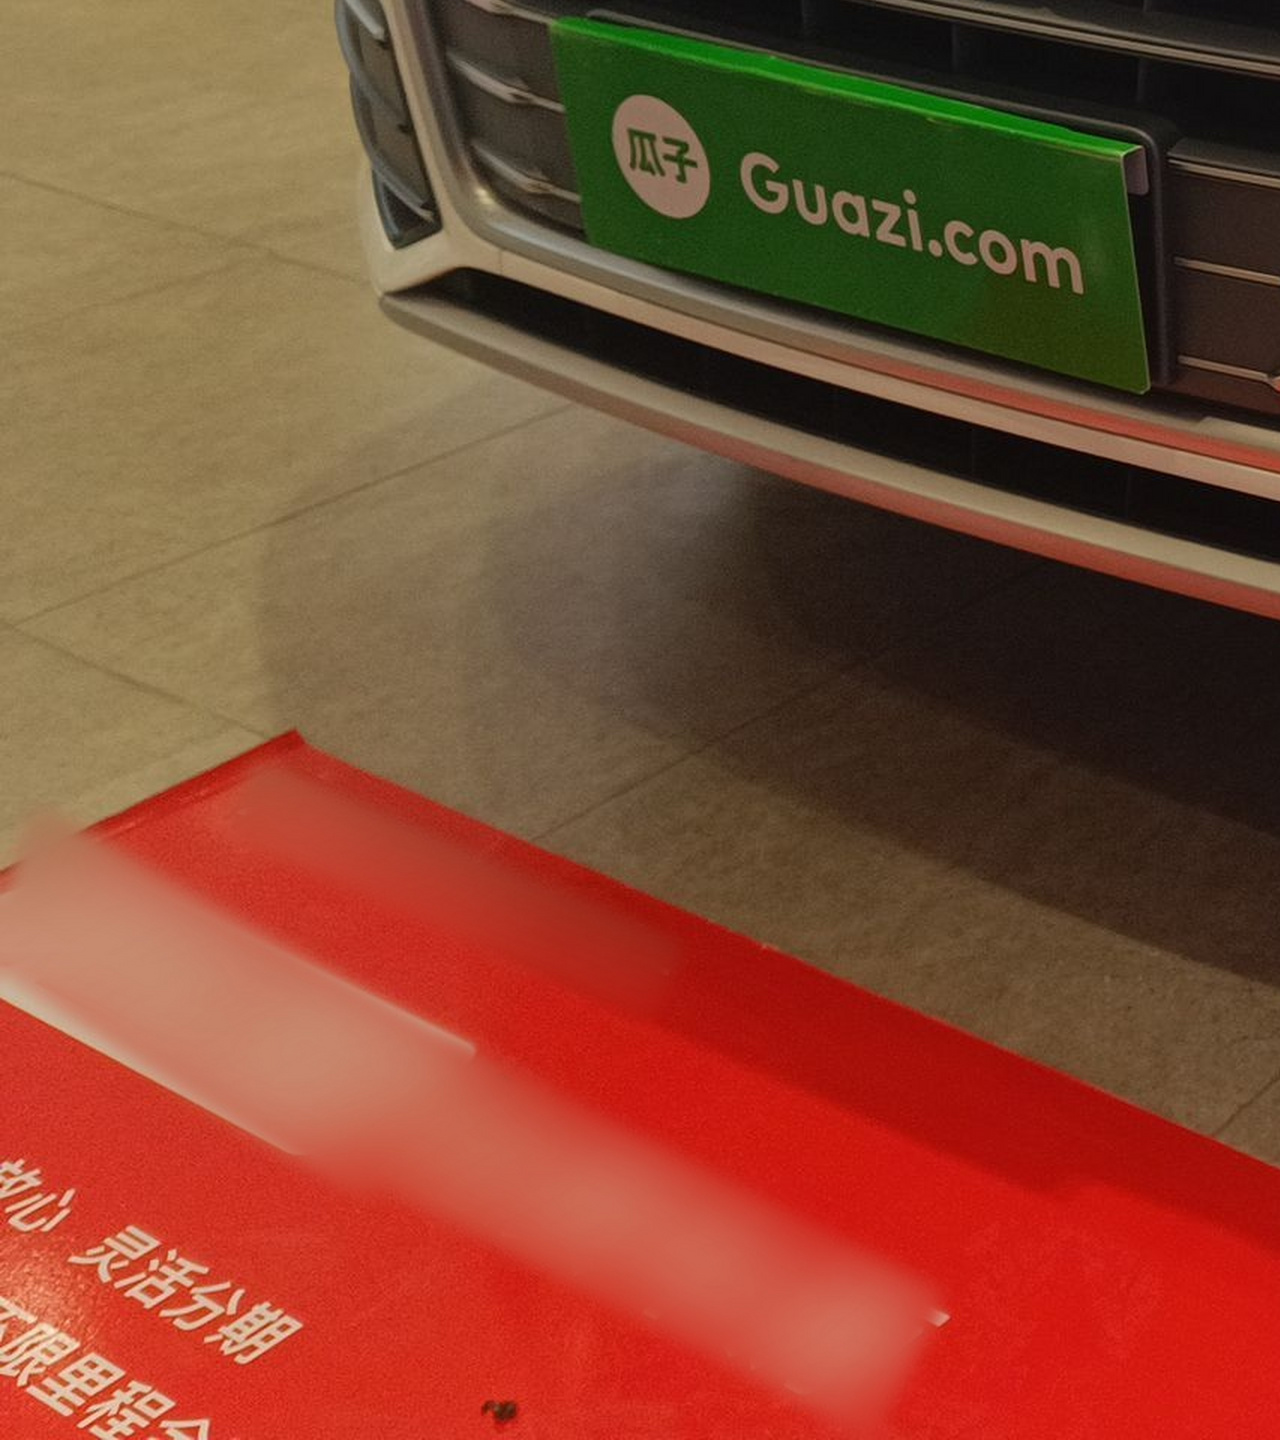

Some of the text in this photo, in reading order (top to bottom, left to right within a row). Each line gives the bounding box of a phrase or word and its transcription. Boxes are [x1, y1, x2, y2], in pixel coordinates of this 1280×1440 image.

[627, 127, 699, 184] 瓜子
[739, 151, 1085, 295] Guazi.com
[67, 1224, 304, 1365] 灵活分期
